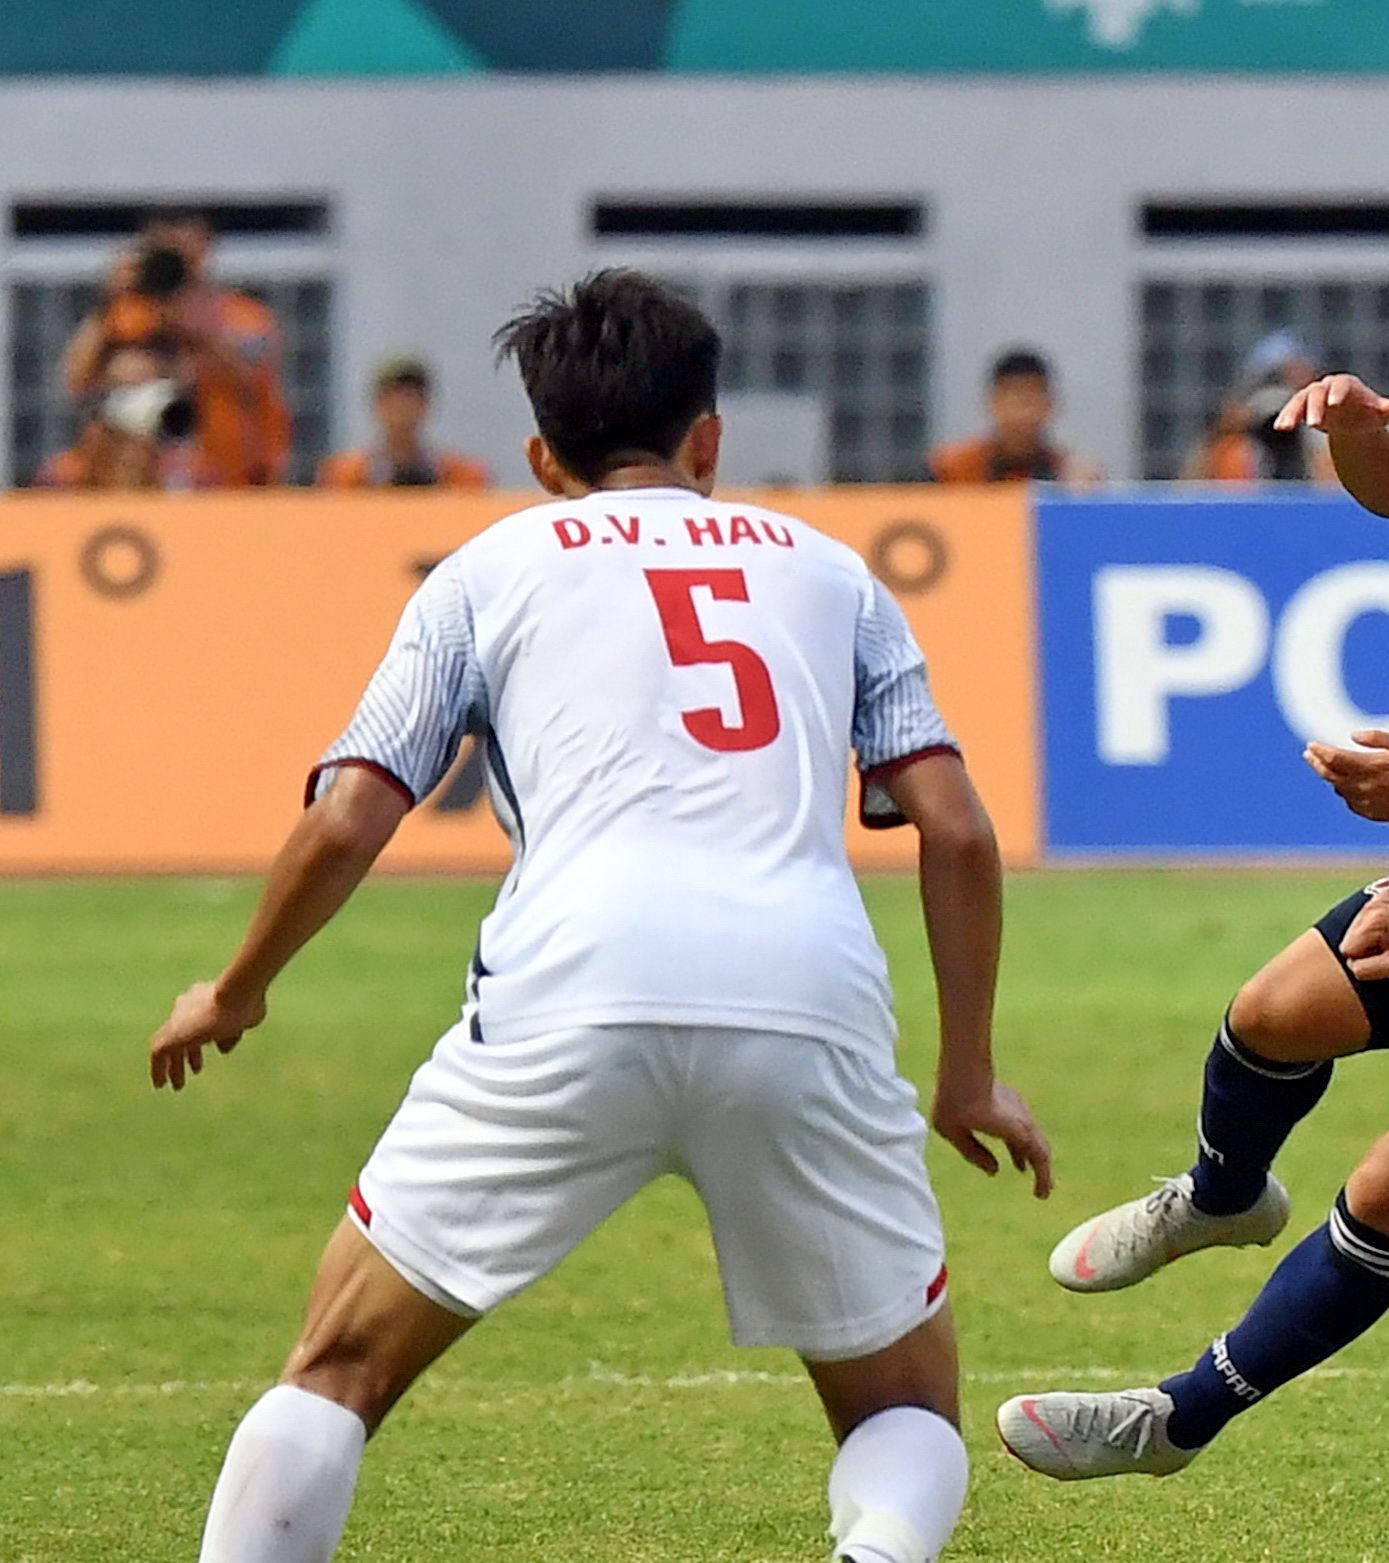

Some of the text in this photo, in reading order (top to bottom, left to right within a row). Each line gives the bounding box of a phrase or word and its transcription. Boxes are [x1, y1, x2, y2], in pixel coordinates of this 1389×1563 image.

[552, 515, 795, 550] D.V. HAU
[643, 568, 780, 753] 5
